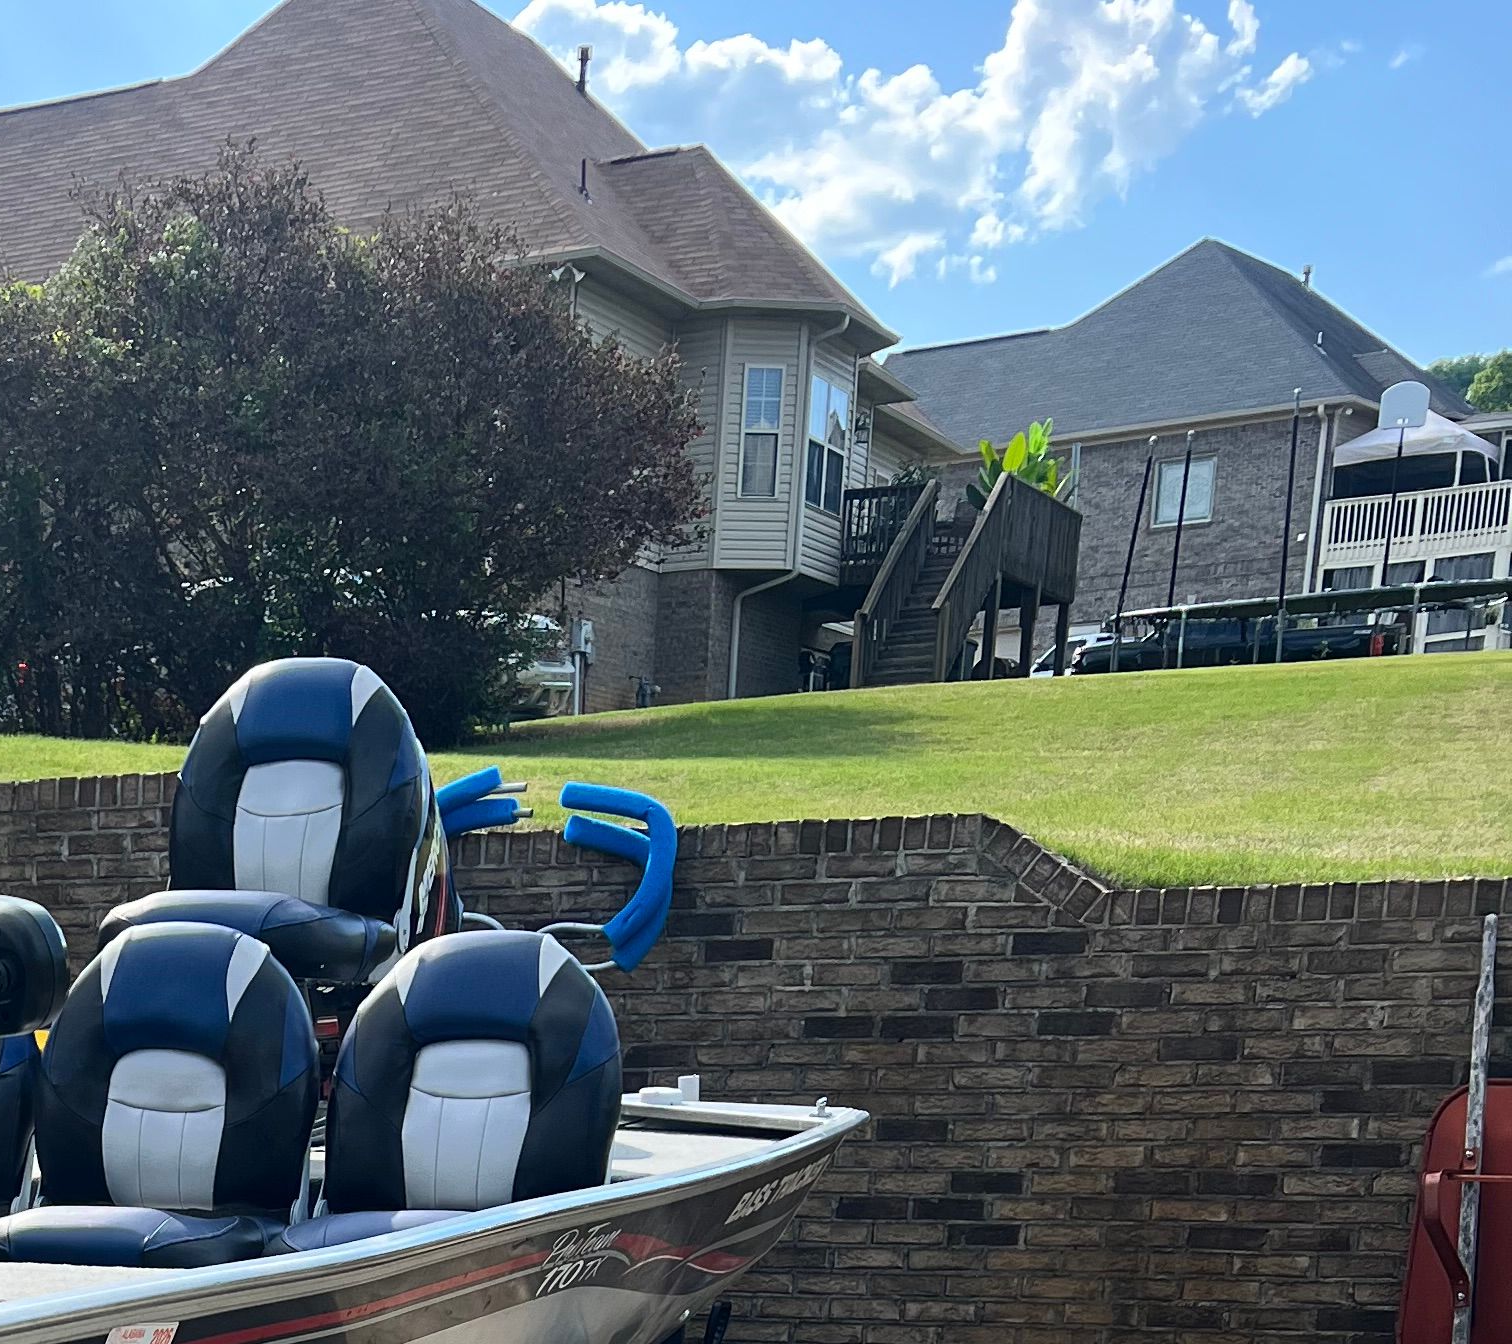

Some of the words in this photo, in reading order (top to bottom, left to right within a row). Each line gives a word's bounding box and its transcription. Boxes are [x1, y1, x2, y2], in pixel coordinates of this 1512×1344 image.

[724, 1179, 780, 1225] BASS
[535, 1259, 585, 1297] 170
[578, 1255, 609, 1282] TX
